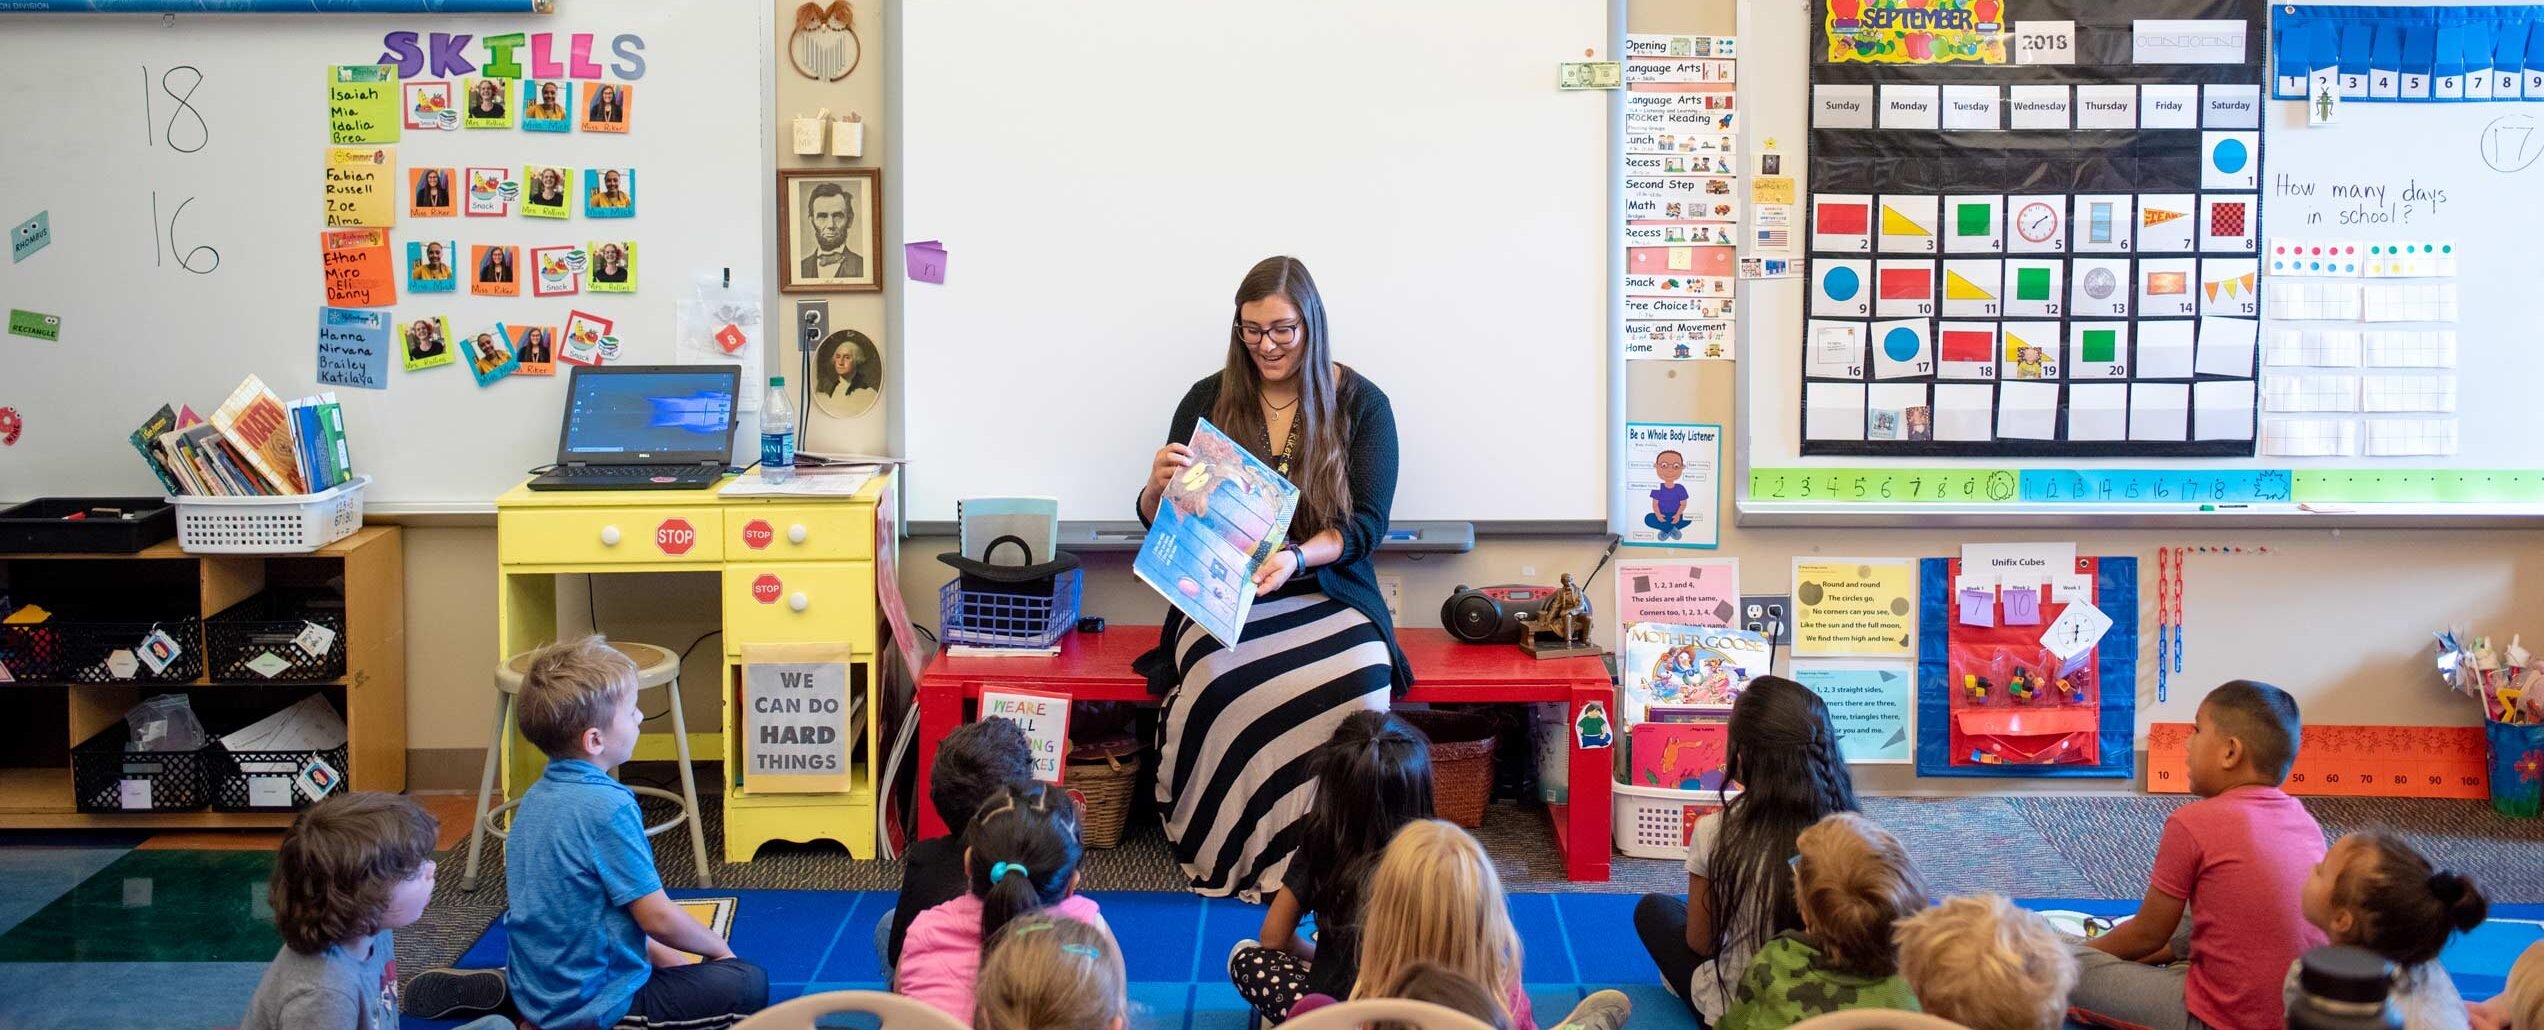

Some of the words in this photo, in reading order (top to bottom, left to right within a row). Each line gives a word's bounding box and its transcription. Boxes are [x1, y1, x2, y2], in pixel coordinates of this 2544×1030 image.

[1863, 8, 1973, 29] SEPTEMBER
[1626, 39, 1667, 52] Opening
[2022, 34, 2068, 50] 2018
[376, 31, 646, 80] SKILLS
[1626, 63, 1671, 76] anguage
[1676, 63, 1701, 73] Arts
[2379, 77, 2388, 88] 4
[2503, 76, 2511, 88] 8
[2533, 76, 2542, 88] 9
[331, 87, 378, 101] Isaiah
[1677, 95, 1702, 105] Arts
[2211, 100, 2251, 111] Saturday
[142, 65, 208, 153] 18
[1826, 101, 1860, 111] Sunday
[1890, 101, 1928, 111] Monday
[1953, 101, 1989, 111] Tuesday
[2014, 101, 2066, 112] Wednesday
[2085, 101, 2128, 112] Thursday
[2155, 101, 2183, 111] Friday
[331, 107, 359, 118] Mia
[1628, 113, 1665, 122] Rocket
[1668, 114, 1711, 126] Reading
[332, 120, 374, 132] Idalia
[333, 131, 366, 144] Brea
[2494, 126, 2534, 163] 17
[1626, 157, 1661, 167] Recess
[326, 168, 375, 181] Fabian
[326, 184, 372, 195] Russell
[1626, 179, 1664, 189] Second
[1668, 179, 1695, 191] Step
[2276, 174, 2315, 197] How
[2333, 184, 2385, 208] many
[2402, 179, 2447, 214] days
[326, 199, 356, 212] Zoe
[472, 202, 495, 210] Snack
[1628, 200, 1656, 210] Math
[328, 214, 363, 227] Alma
[2307, 206, 2322, 225] in
[153, 191, 219, 274] 16
[1626, 227, 1661, 238] Recess
[15, 228, 48, 251] RHOMBUS
[1860, 239, 1868, 249] 2
[1926, 239, 1934, 250] 3
[1992, 239, 2000, 250] 4
[2054, 239, 2062, 250] 5
[2120, 239, 2128, 249] 6
[2183, 239, 2191, 249] 7
[2245, 238, 2253, 249] 8
[323, 252, 366, 266] Ethan
[326, 268, 360, 281] Miro
[337, 278, 352, 291] Eli
[1626, 277, 1655, 287] Snack
[546, 284, 568, 292] Snack
[327, 287, 370, 305] Danny
[1626, 300, 1649, 310] Free
[1653, 300, 1688, 310] Choice
[1859, 303, 1867, 314] 9
[1917, 303, 1932, 314] 10
[1984, 303, 1997, 314] 11
[2046, 304, 2058, 314] 12
[2112, 303, 2125, 314] 13
[2179, 302, 2193, 313] 14
[2241, 302, 2254, 313] 15
[12, 324, 56, 338] RECTANGLE
[1626, 323, 1651, 333] Music
[1655, 323, 1673, 333] and
[1677, 322, 1726, 332] Movement
[320, 328, 365, 342] Hanna
[726, 334, 737, 345] 8
[319, 343, 373, 356] Nirvana
[1626, 343, 1653, 353] Home
[568, 350, 590, 362] Snack
[320, 356, 366, 377] Brailey
[1847, 366, 1861, 376] 16
[1917, 362, 1929, 373] 17
[1979, 366, 1993, 376] 18
[2043, 365, 2057, 376] 19
[2109, 365, 2124, 376] 20
[236, 397, 286, 450] MATH
[1630, 429, 1638, 440] Be
[1640, 432, 1645, 440] a
[1647, 429, 1667, 440] Whole
[1669, 429, 1686, 444] Body
[1687, 430, 1715, 442] Listener
[658, 529, 693, 544] STOP
[746, 530, 771, 540] STOP
[1992, 558, 2018, 567] Unifix
[2019, 557, 2046, 567] Cubes
[755, 585, 780, 594] STOP
[2013, 593, 2031, 617] 10
[1632, 630, 1705, 650] MOTHER
[1705, 635, 1765, 652] GOOSE
[1850, 635, 1867, 643] high
[780, 672, 814, 688] WE
[755, 697, 800, 713] CAN
[808, 698, 839, 713] DO
[993, 700, 1014, 713] WE
[1015, 701, 1047, 716] ARE
[760, 726, 836, 744] HARD
[757, 754, 836, 770] THINGS
[2158, 770, 2169, 780] 10
[2292, 773, 2305, 783] 50
[2326, 774, 2339, 783] 60
[2360, 774, 2373, 784] 70
[2394, 774, 2408, 784] 80
[2428, 775, 2442, 785] 90
[2460, 775, 2480, 786] 100
